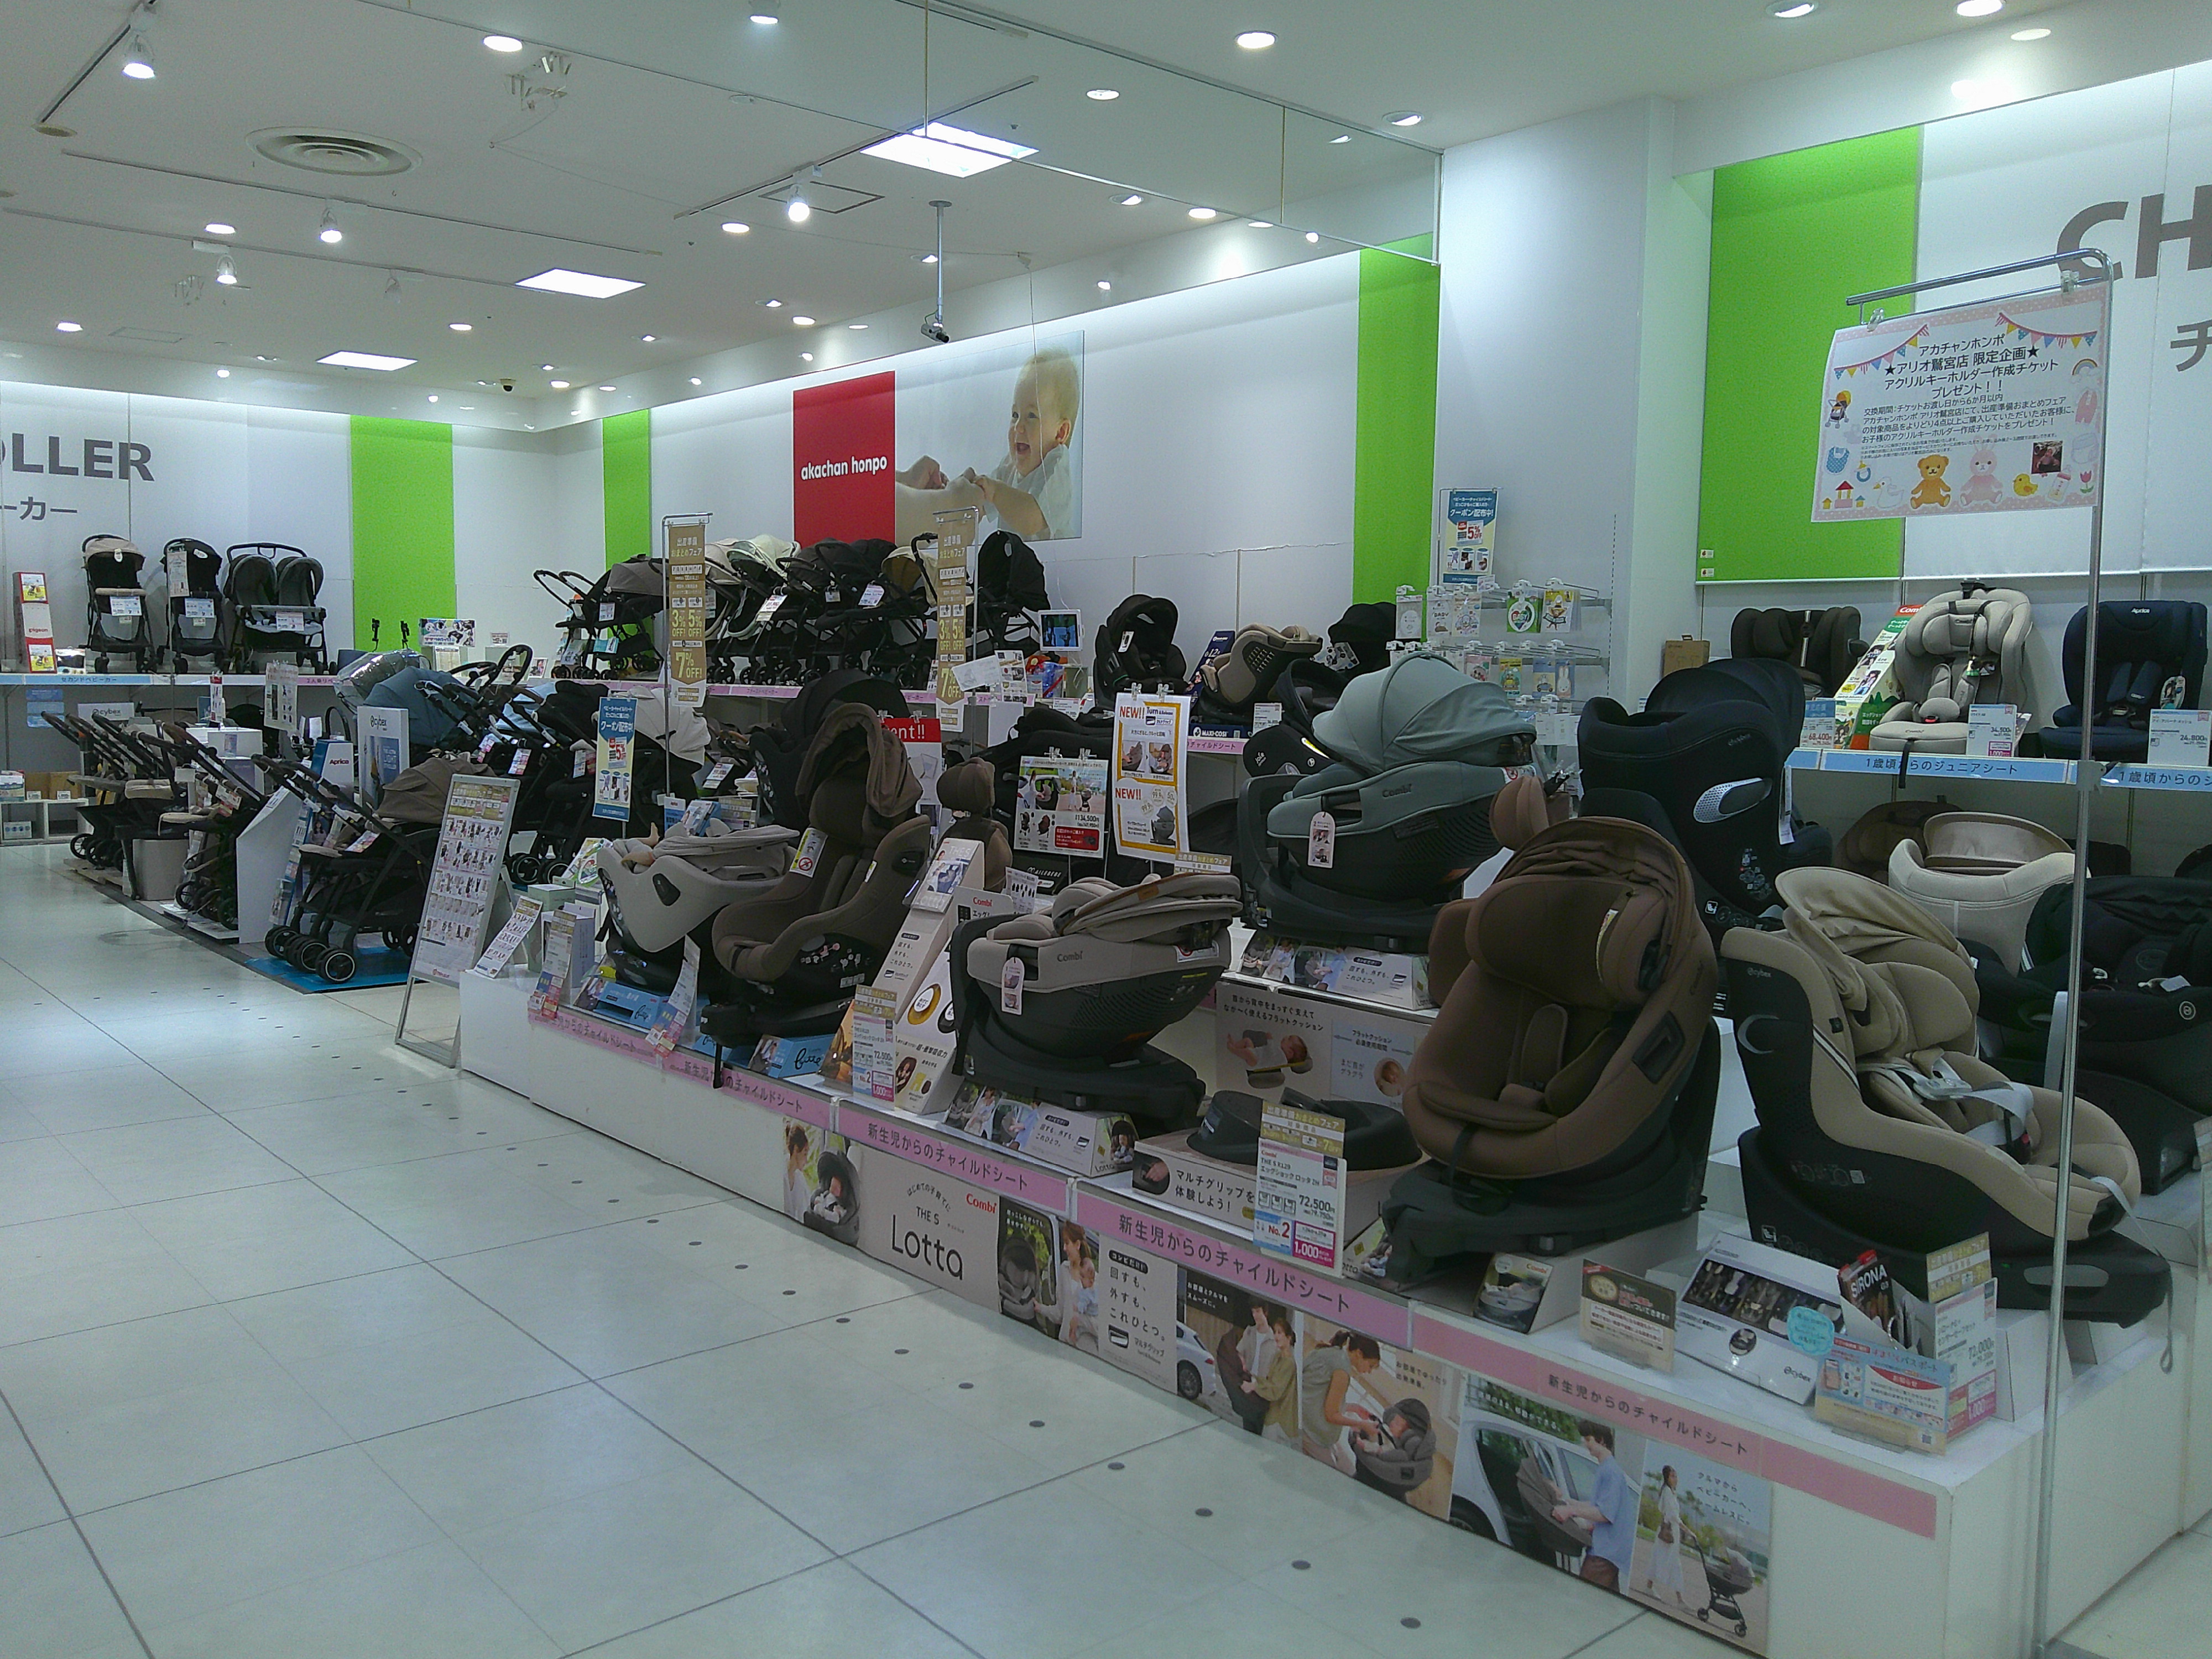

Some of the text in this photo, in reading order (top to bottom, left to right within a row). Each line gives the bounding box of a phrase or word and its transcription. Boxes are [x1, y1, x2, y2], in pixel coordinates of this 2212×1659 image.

[1919, 333, 2005, 356] アカチャンホンポ
[1973, 346, 2026, 367] 限定企画
[1884, 358, 2059, 390] アクリルキーホルダー作成チケット
[1863, 412, 1918, 425] アカチャンホンポ
[0, 432, 155, 482] LLER
[801, 455, 888, 481] akachan honpo
[1449, 508, 1494, 518] クーポン配布中!
[672, 609, 702, 629] 3% 5%
[672, 628, 702, 637] OFF! OFF!
[686, 667, 702, 679] OFF!
[1119, 706, 1145, 719] NEW!!
[1115, 787, 1141, 800] NEW!!
[973, 896, 993, 907] Combi
[1057, 951, 1083, 963] Combi
[1231, 994, 1315, 1020] 首から背中をまっすぐ支えて
[1352, 1029, 1392, 1044] フラットクッション
[1340, 1068, 1365, 1080] グラグラ
[684, 1060, 803, 1113] 新生児のチャイルドシート
[868, 1121, 1027, 1191] 新生児からのチャイルドシート
[1261, 1150, 1277, 1159] Combi
[1261, 1157, 1272, 1167] THE
[1277, 1161, 1291, 1170] R129
[1261, 1165, 1294, 1180] エッグショック
[1295, 1173, 1311, 1185] ロッタ
[1175, 1168, 1255, 1204] マルチグリップを
[907, 1182, 951, 1213] はじめての子育てに
[966, 1193, 997, 1214] Combi
[1175, 1185, 1231, 1213] 体験しよう!
[1298, 1194, 1336, 1214] 72,500円
[916, 1206, 940, 1225] THE S
[1268, 1221, 1291, 1239] No.2
[892, 1214, 963, 1281] Lotta
[1294, 1241, 1319, 1259] 1,000
[1119, 1214, 1349, 1313] 新生児からのチャイルドシート
[1109, 1266, 1146, 1291] 回すも、
[1851, 1264, 1888, 1299] SIRONA
[1109, 1286, 1146, 1311] 外すも、
[1109, 1307, 1166, 1342] これひとつ。
[1133, 1337, 1165, 1358] マルチグリップ
[1548, 1374, 1748, 1457] 新生児からのチャイルドシート
